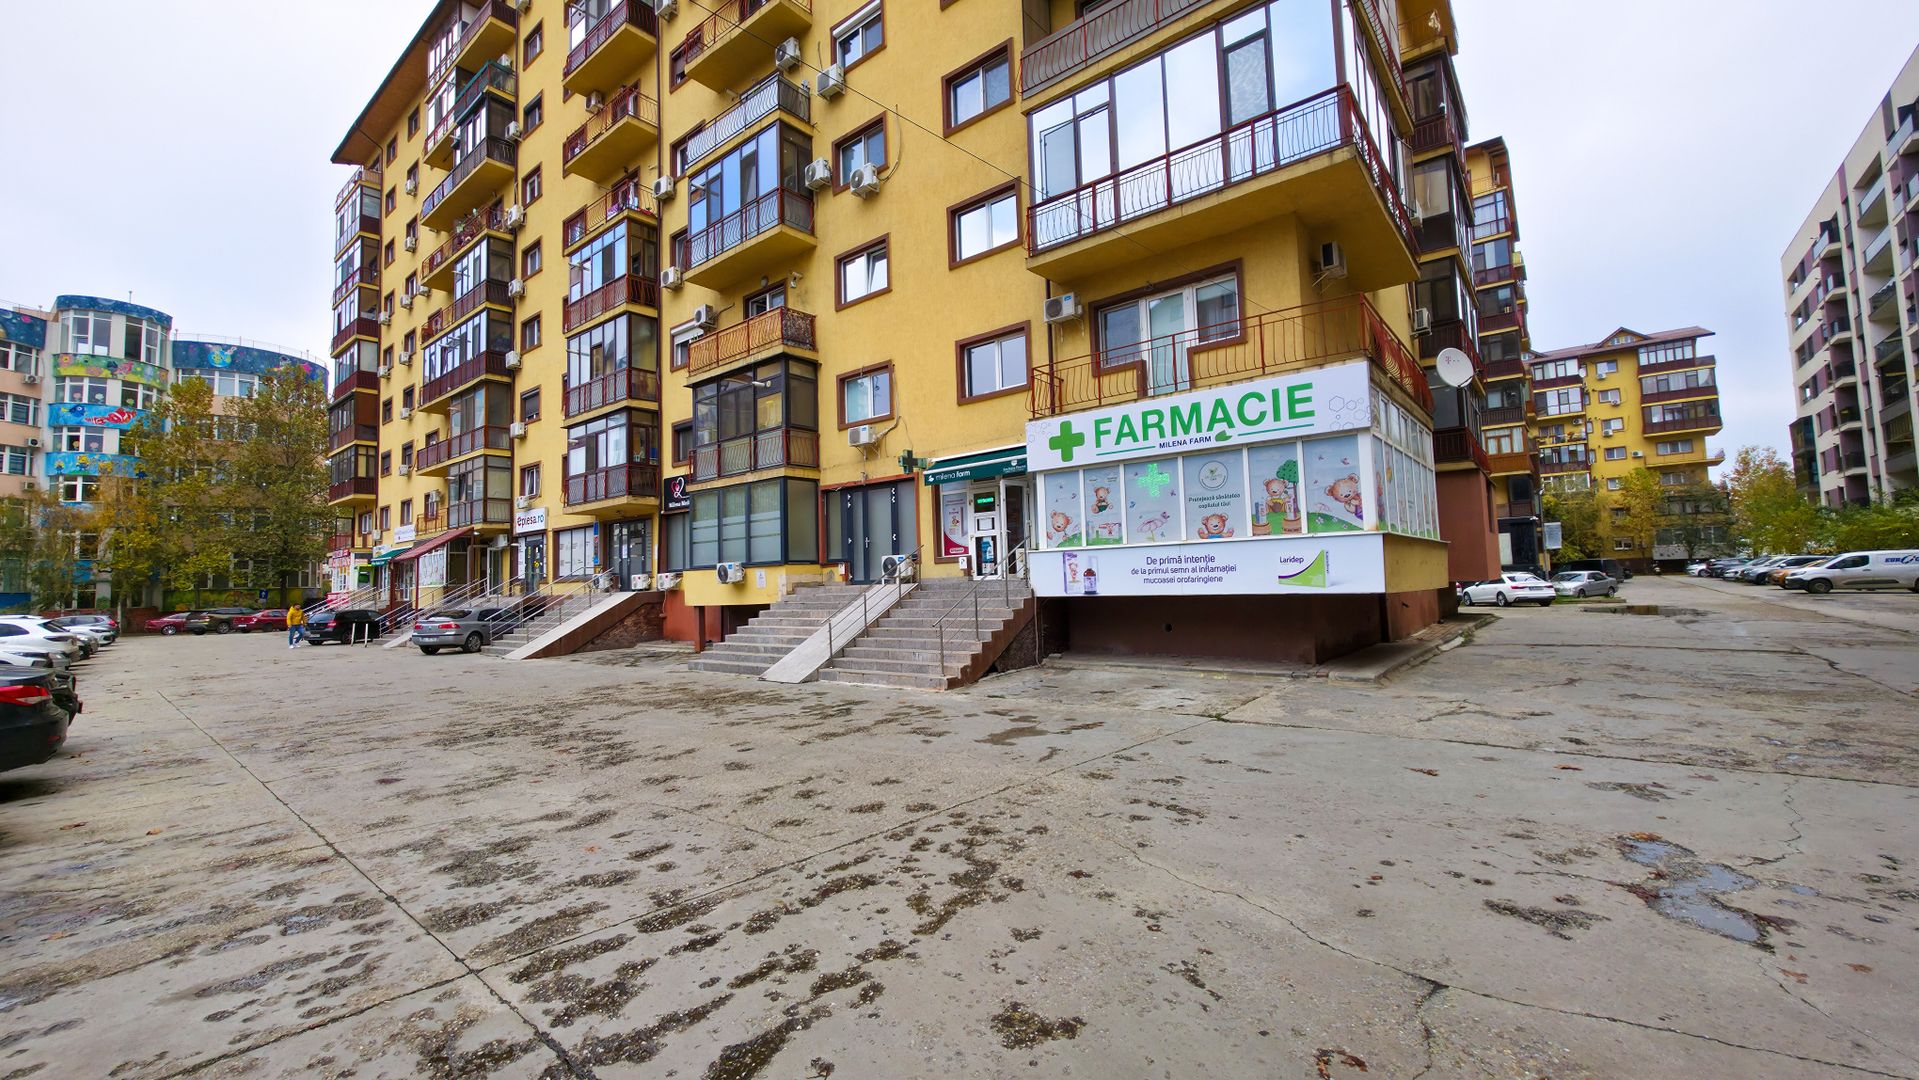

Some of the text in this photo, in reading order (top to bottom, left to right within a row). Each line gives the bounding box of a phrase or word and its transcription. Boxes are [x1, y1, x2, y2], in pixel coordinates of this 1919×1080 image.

[1094, 382, 1316, 448] FARMACIE
[1159, 435, 1212, 449] MILENA FARM
[936, 470, 971, 481] milena farm
[517, 514, 545, 528] epiesa.ro
[1146, 554, 1216, 566] De primă intenție
[1279, 556, 1305, 564] Laridep
[1148, 566, 1169, 576] primul
[1170, 566, 1190, 574] semn
[1190, 565, 1198, 573] al
[1198, 564, 1237, 574] inflamației
[1143, 574, 1223, 584] mucoasei orofaringiene
